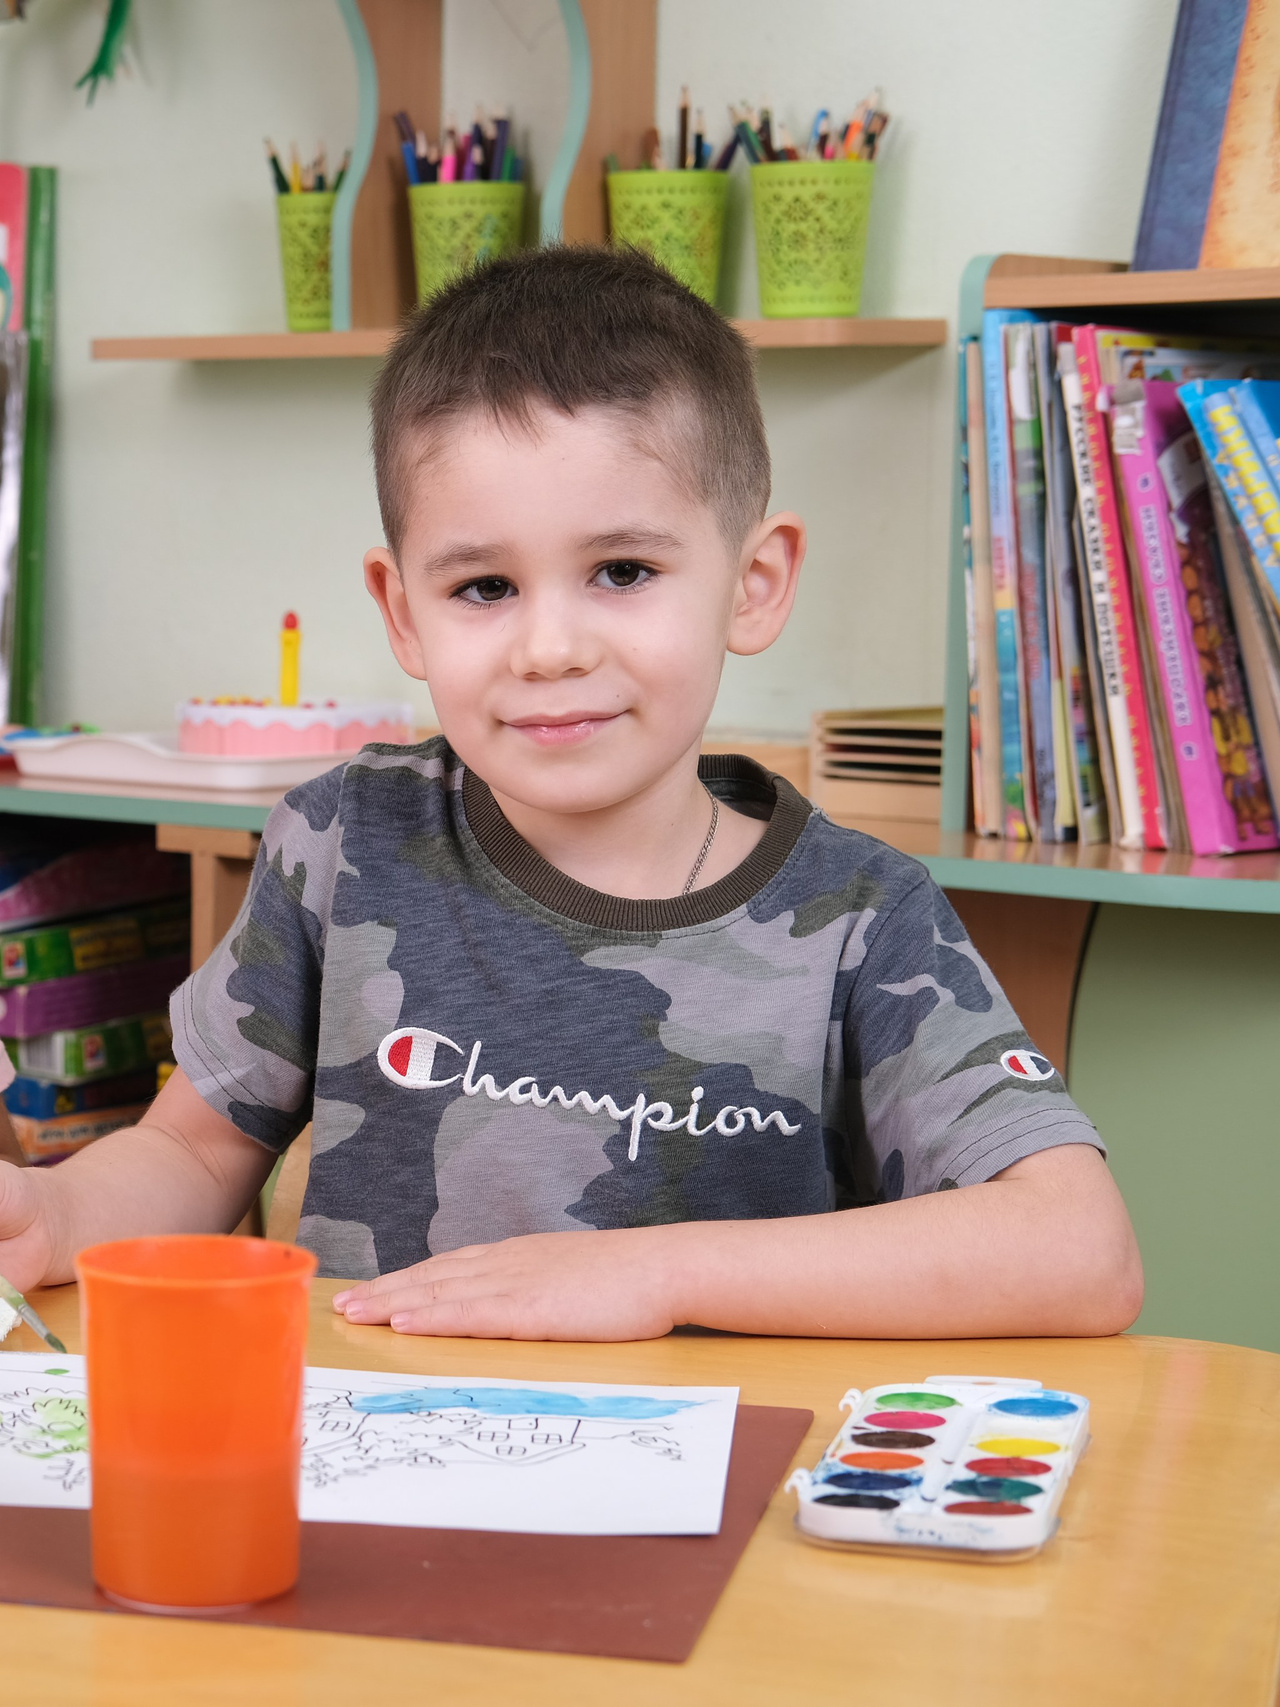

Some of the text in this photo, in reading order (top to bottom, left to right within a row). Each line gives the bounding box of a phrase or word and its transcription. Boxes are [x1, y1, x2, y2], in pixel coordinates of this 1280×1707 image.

[1072, 405, 1092, 486] РУССКИЕ
[1085, 499, 1102, 572] СКАЗКИ
[1094, 583, 1106, 594] И
[1209, 405, 1280, 556] АВРИКИ
[377, 1026, 802, 1161] Champion
